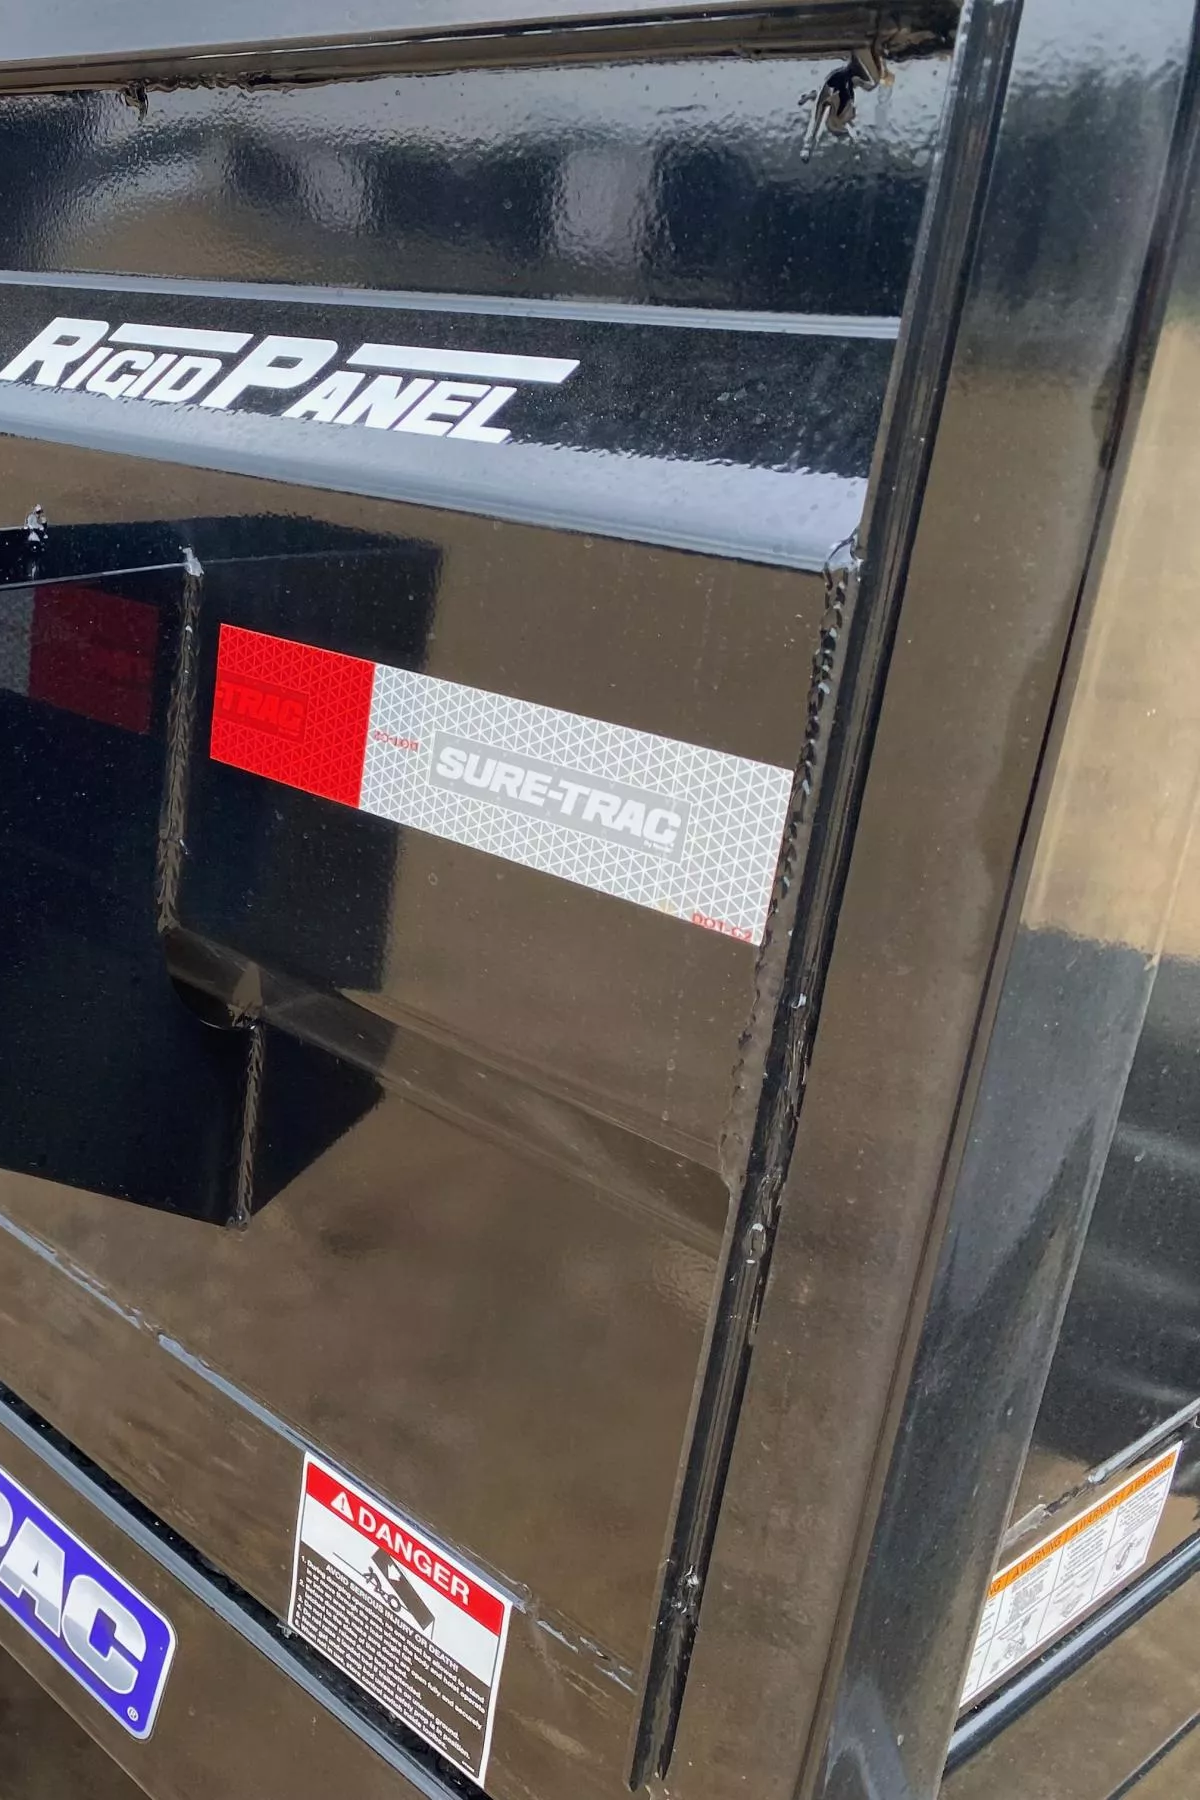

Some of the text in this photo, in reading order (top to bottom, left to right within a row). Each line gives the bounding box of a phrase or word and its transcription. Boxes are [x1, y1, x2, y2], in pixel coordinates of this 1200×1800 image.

[200, 334, 518, 444] PANEL
[436, 746, 682, 846] SURE-TRAC
[358, 1505, 470, 1606] DANGER
